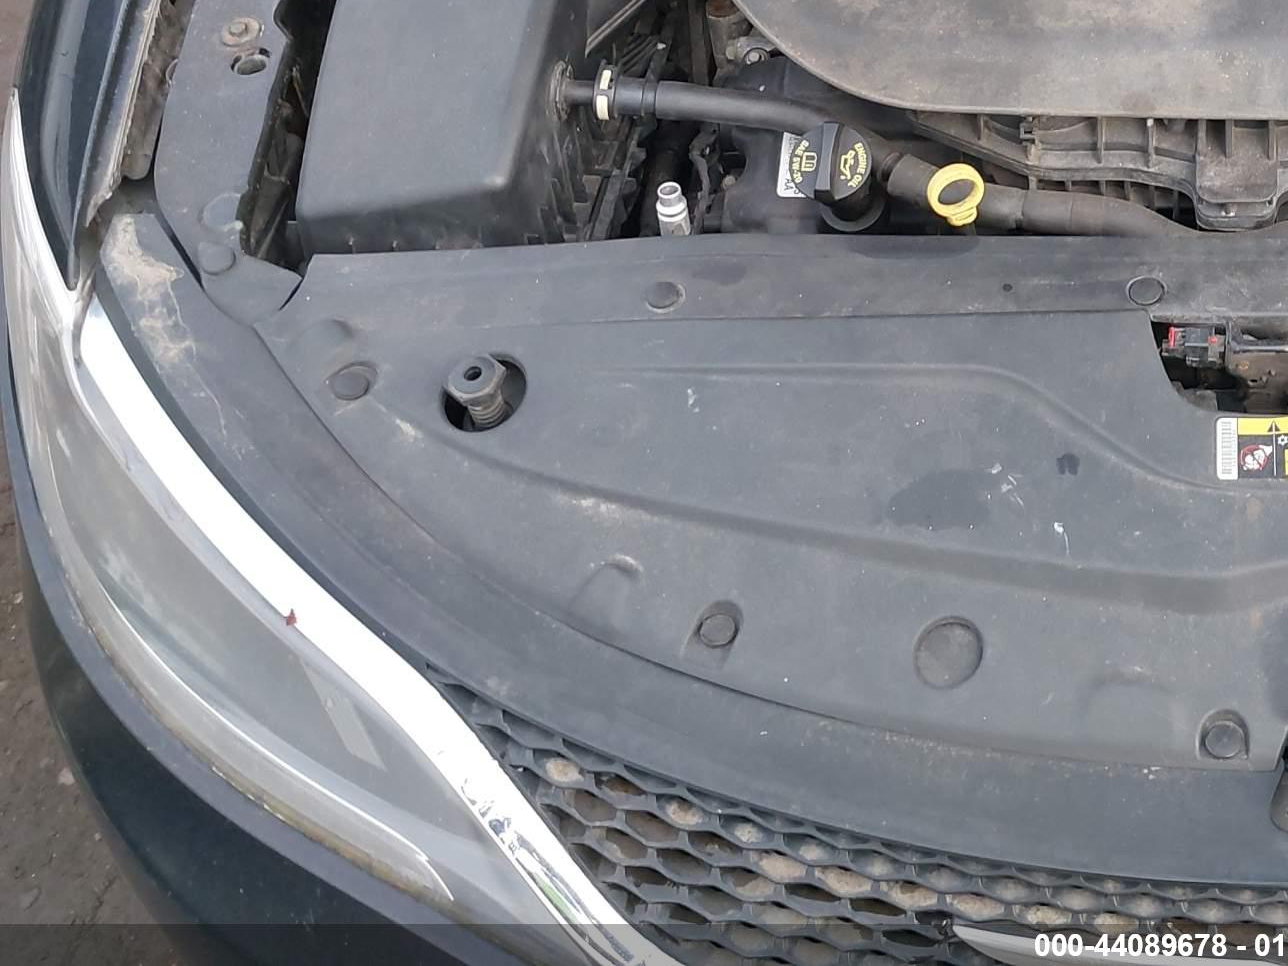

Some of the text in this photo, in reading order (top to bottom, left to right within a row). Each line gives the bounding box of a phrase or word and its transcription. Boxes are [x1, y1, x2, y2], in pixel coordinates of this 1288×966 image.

[795, 140, 810, 156] SAE
[847, 142, 867, 187] ENGINE OIL
